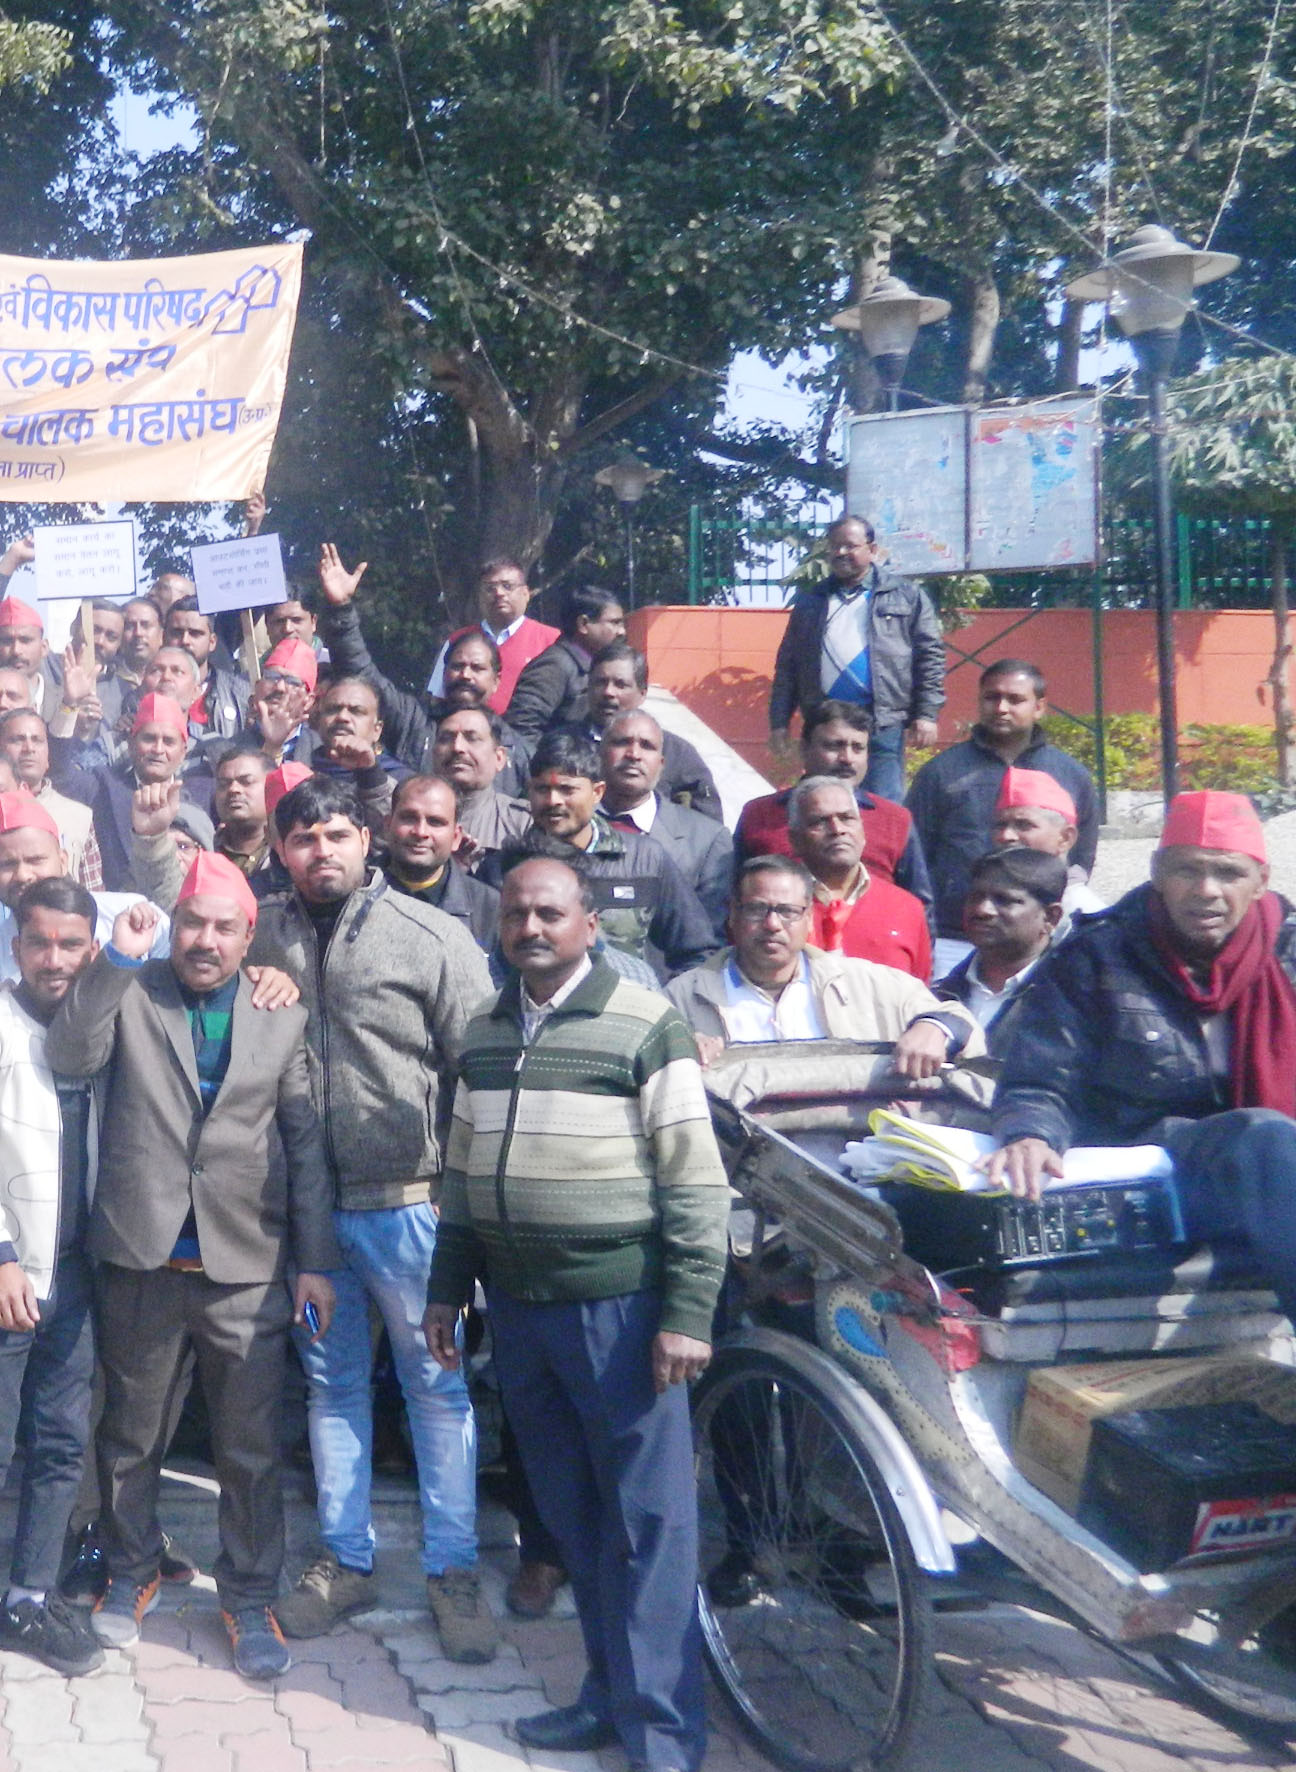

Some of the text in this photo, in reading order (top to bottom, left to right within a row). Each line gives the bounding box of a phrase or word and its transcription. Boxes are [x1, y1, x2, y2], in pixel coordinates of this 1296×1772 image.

[21, 273, 121, 333] विकास
[0, 408, 100, 447] चालक
[106, 388, 246, 447] महासंघ
